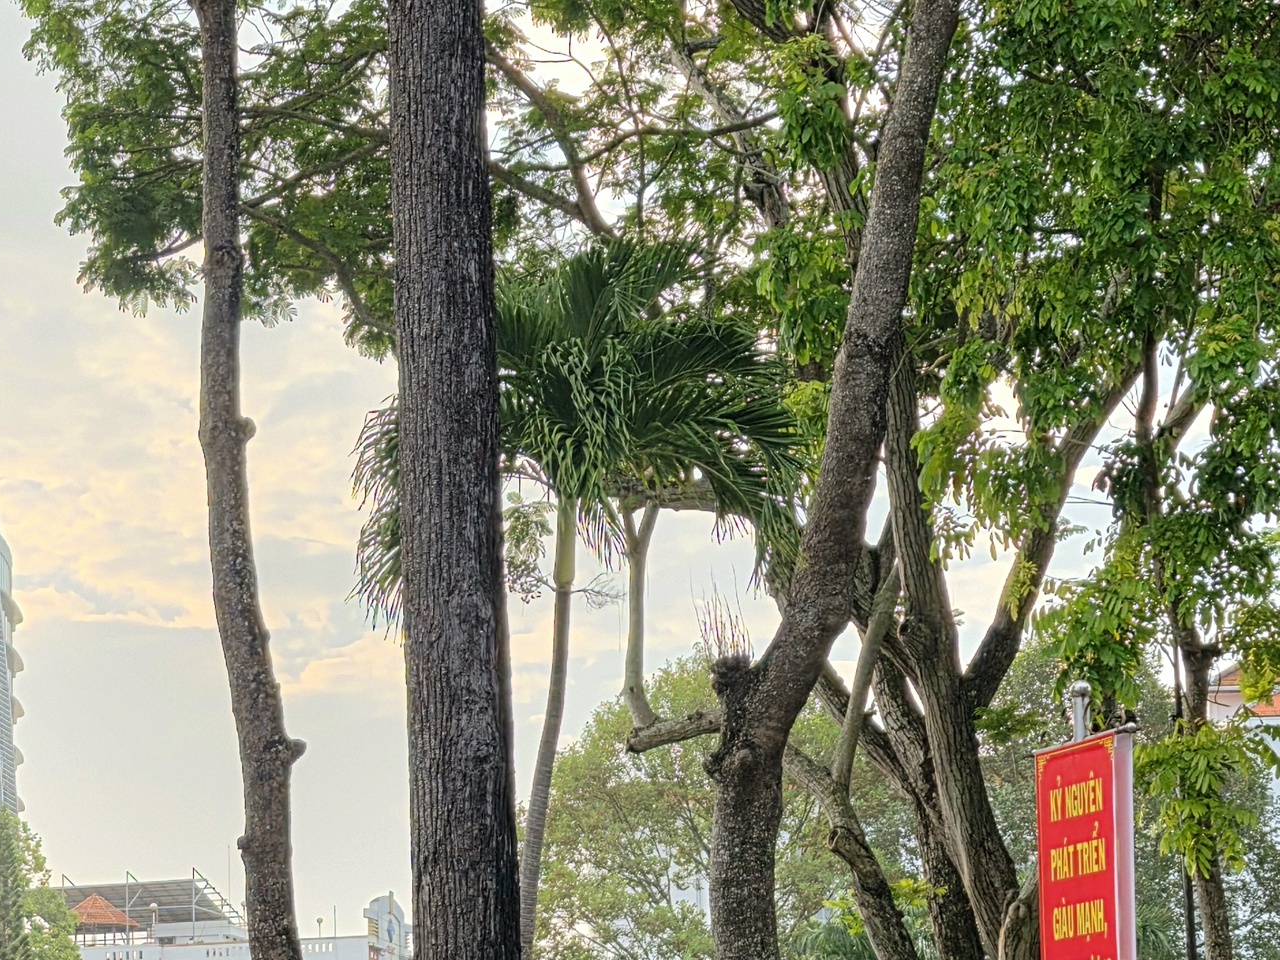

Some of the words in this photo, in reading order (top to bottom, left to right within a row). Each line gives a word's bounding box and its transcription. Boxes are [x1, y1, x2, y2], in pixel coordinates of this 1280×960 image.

[1050, 776, 1062, 821] KỶ
[1065, 771, 1102, 822] NGUYÊN
[1051, 838, 1074, 881] PHÁT
[1077, 821, 1105, 875] TRIỂN
[1053, 898, 1074, 940] GIÀU
[1077, 899, 1107, 941] MẠNH,
